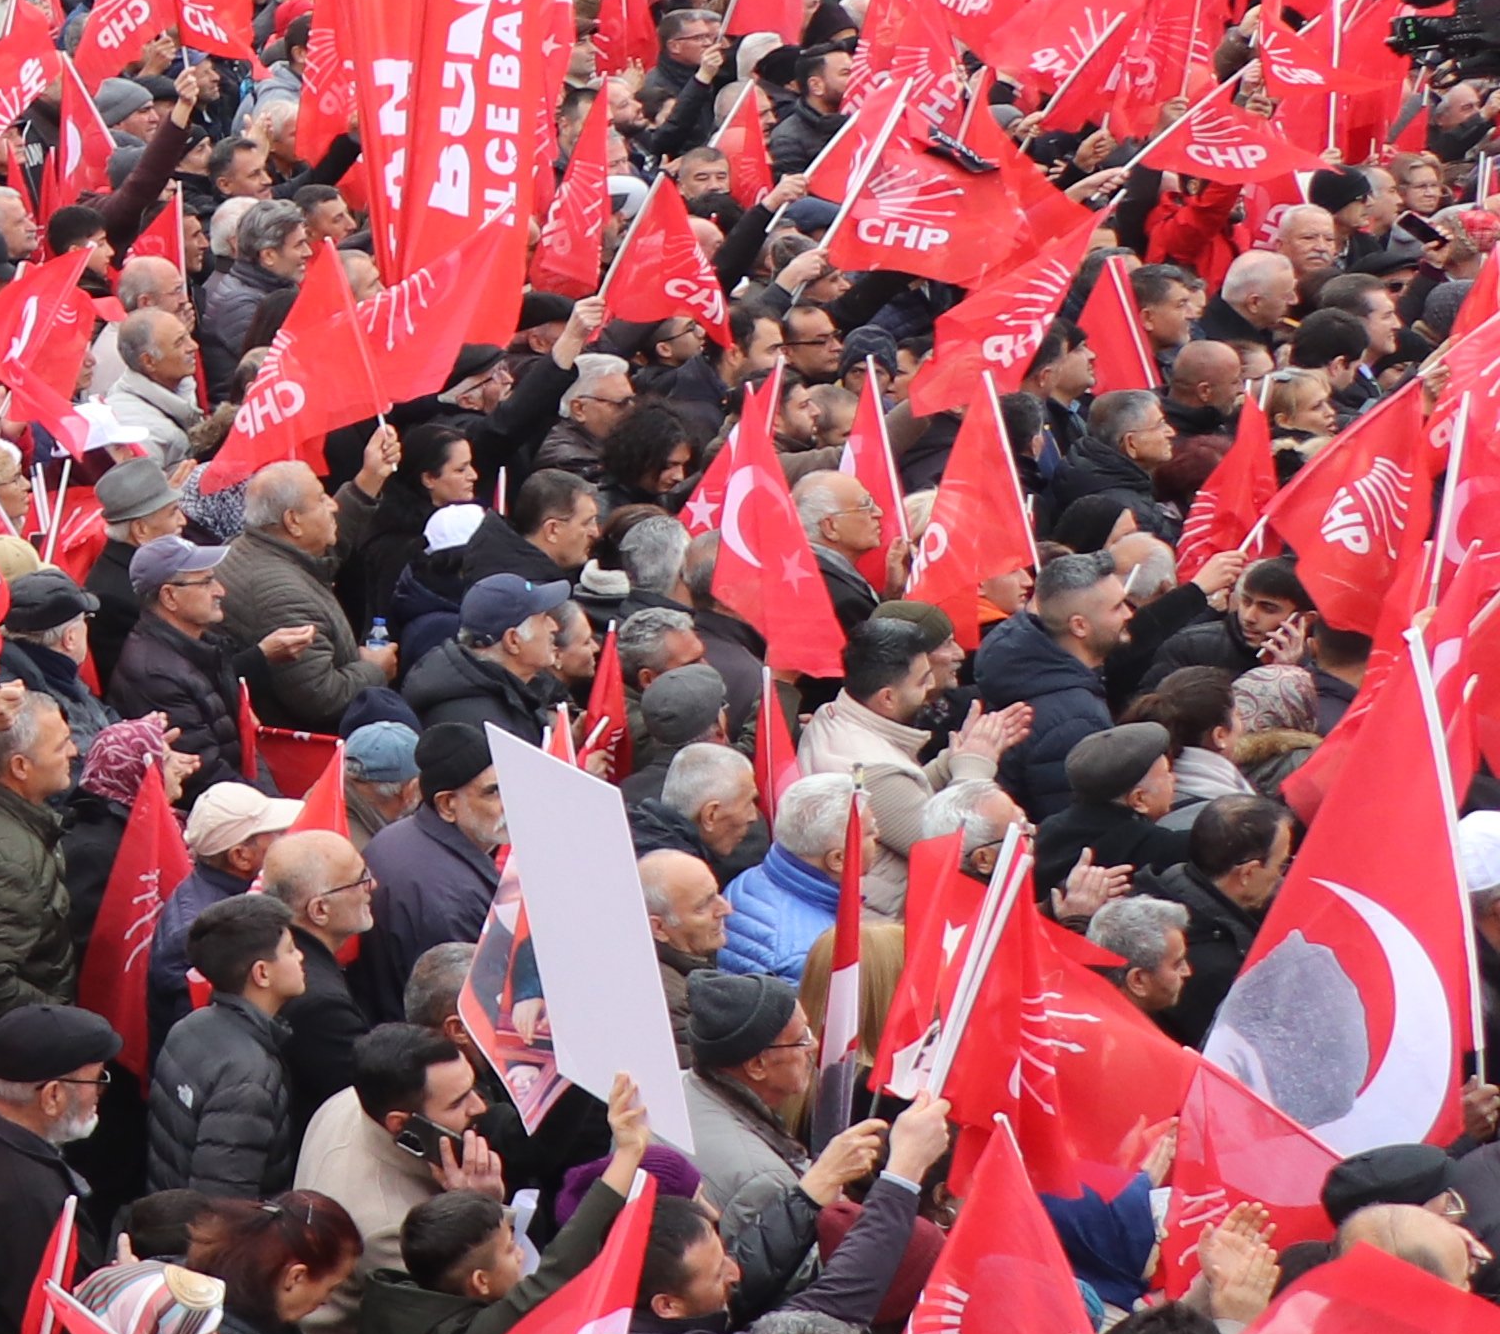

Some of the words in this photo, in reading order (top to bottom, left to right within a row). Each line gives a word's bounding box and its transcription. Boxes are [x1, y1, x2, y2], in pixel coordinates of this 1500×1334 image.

[184, 9, 226, 42] CH
[1187, 141, 1266, 169] CHP
[857, 218, 949, 248] CHP
[664, 278, 723, 325] CH
